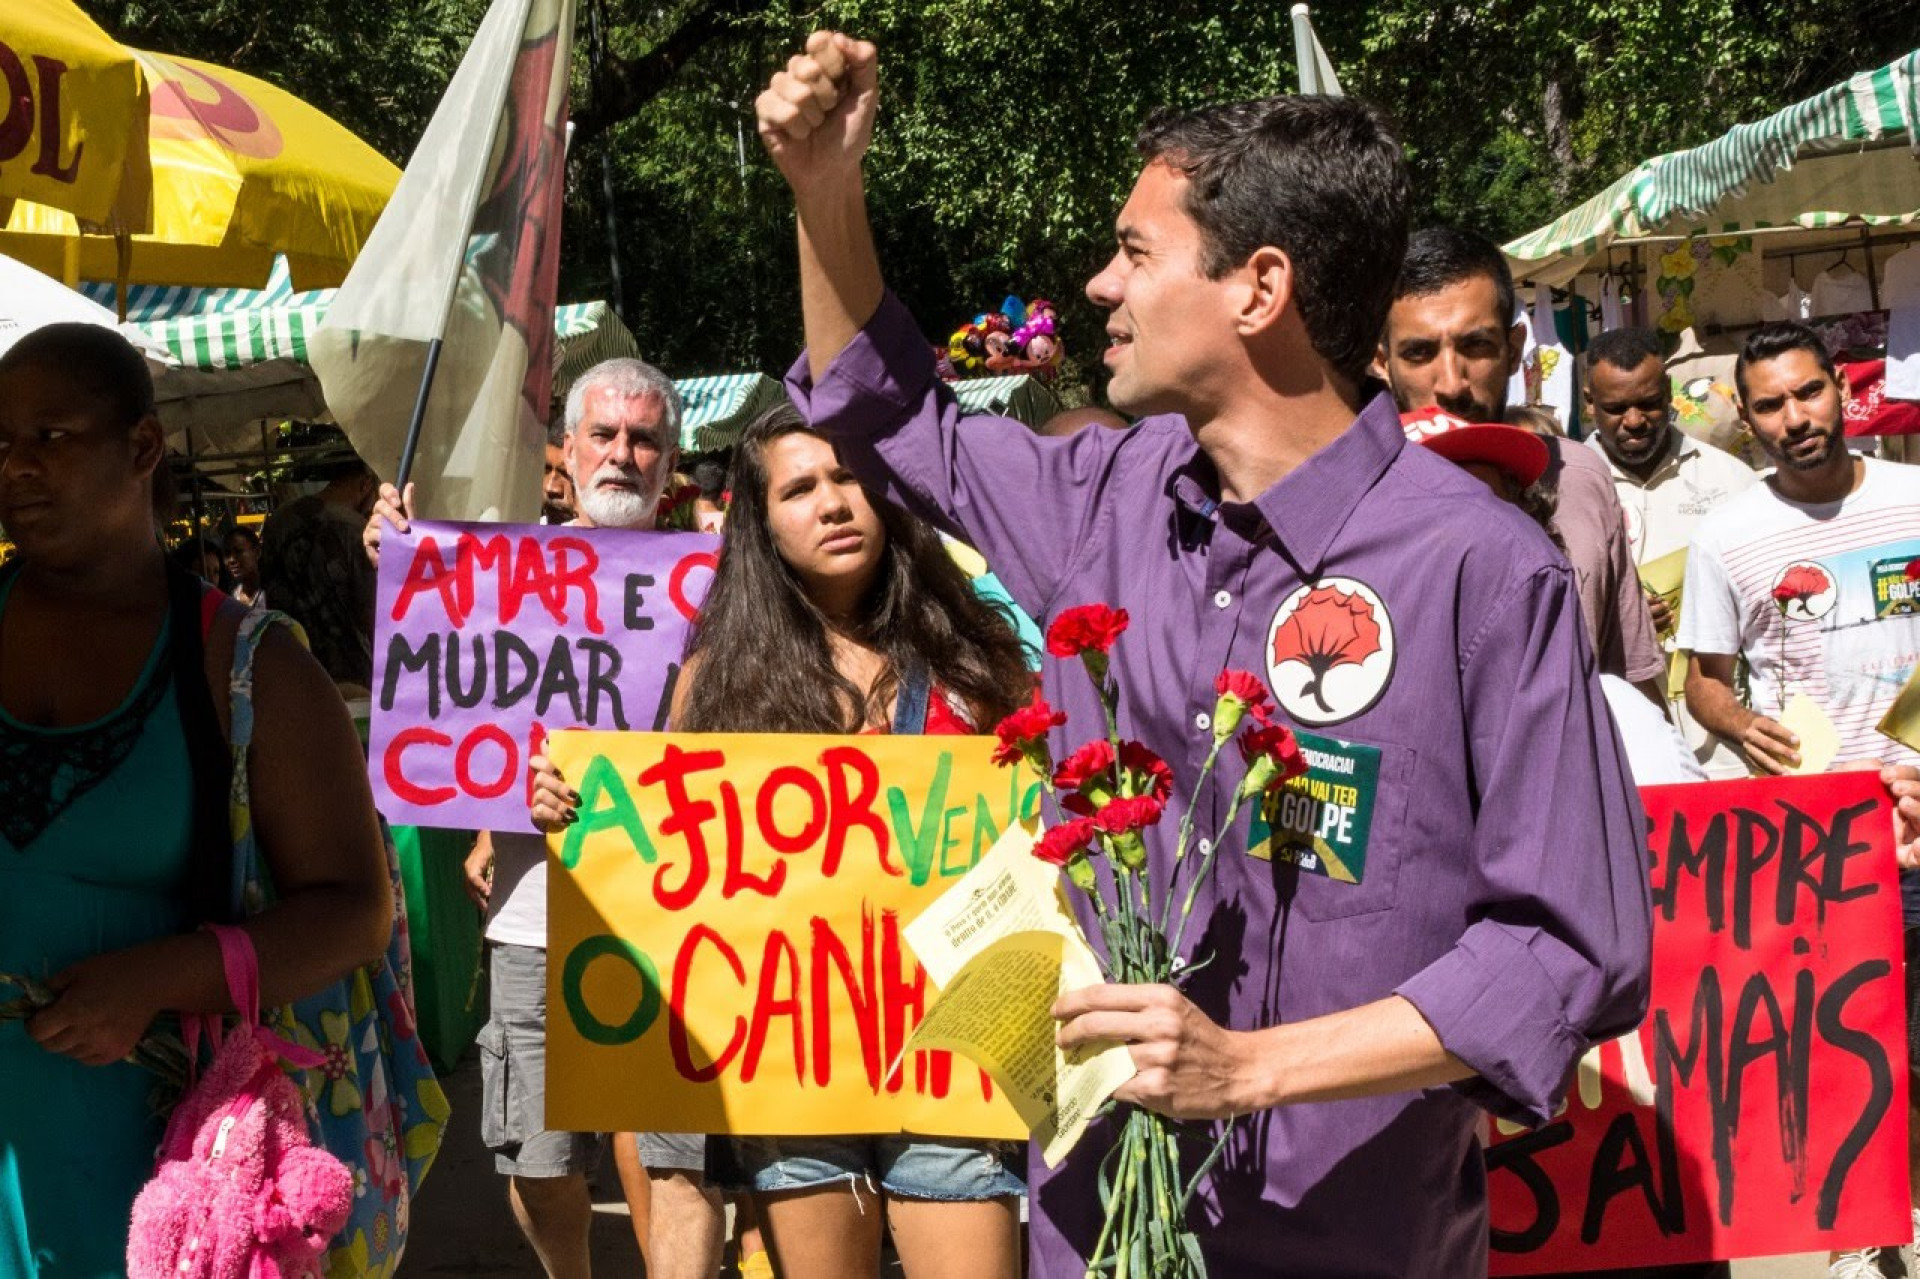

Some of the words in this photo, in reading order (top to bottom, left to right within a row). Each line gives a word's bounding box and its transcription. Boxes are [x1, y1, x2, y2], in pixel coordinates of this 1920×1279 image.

[391, 530, 605, 634] AMAR
[624, 573, 655, 631] E
[380, 630, 631, 730] MUDAR
[383, 722, 588, 808] COI
[1333, 783, 1358, 808] TER
[561, 754, 658, 869] A
[638, 744, 904, 911] FLOR
[562, 933, 660, 1045] O
